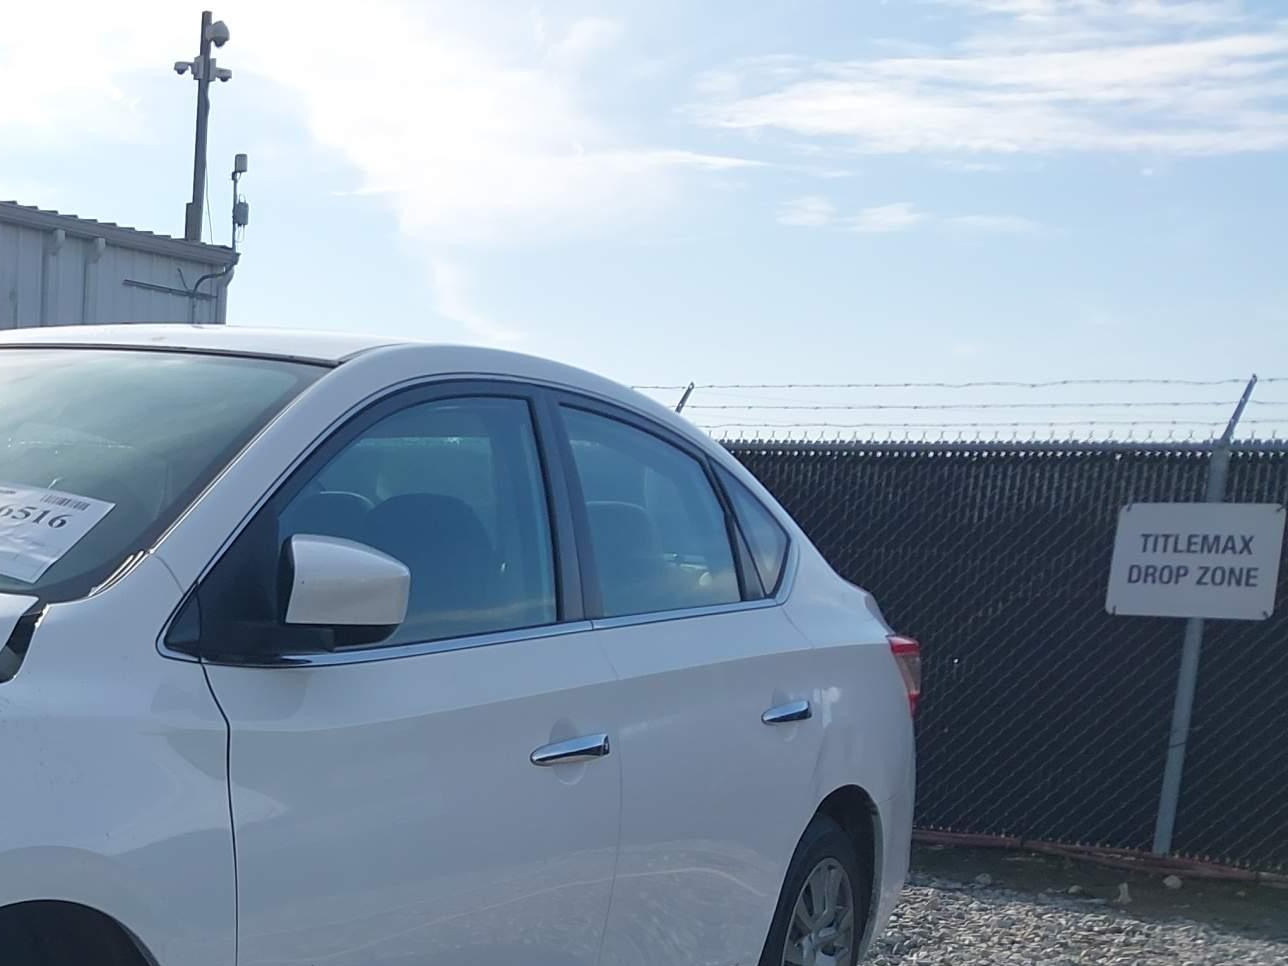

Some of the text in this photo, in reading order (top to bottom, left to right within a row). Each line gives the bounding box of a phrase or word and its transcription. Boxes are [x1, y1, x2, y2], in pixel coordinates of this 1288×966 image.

[1140, 533, 1255, 555] TITLEMAX
[1127, 564, 1259, 587] DROP ZONE
